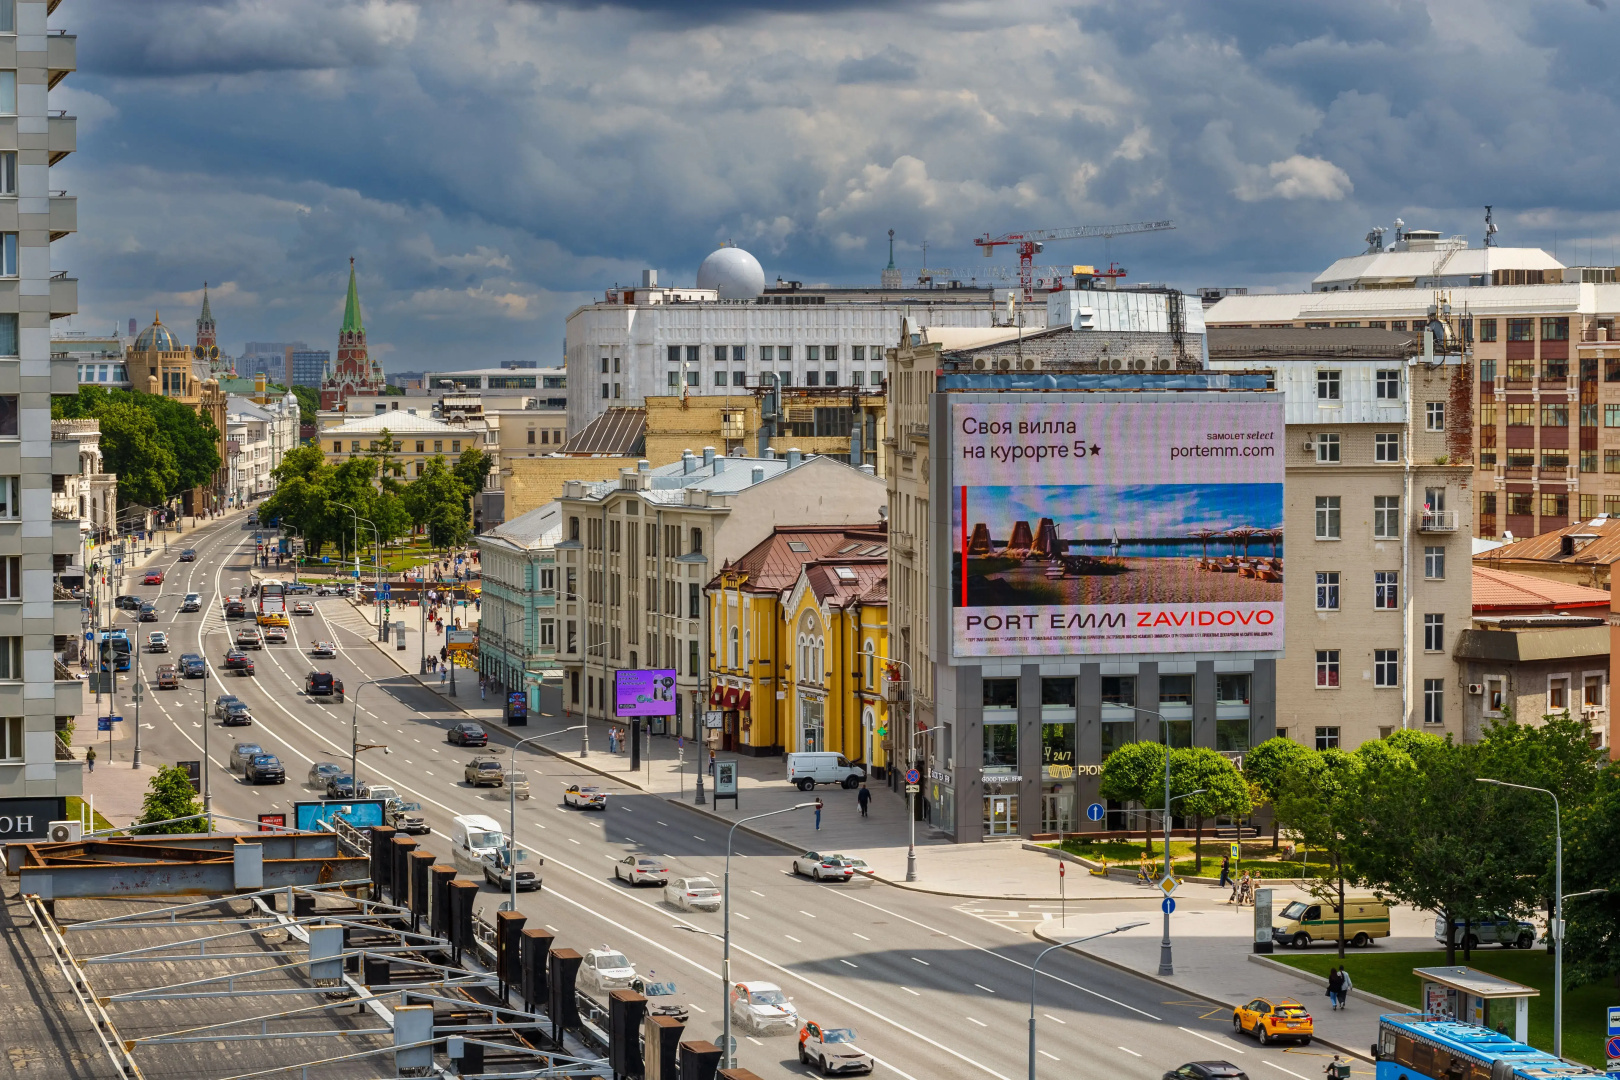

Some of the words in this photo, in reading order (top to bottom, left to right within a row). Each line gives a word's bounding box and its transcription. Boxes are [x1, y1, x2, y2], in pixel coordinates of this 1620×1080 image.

[962, 417, 1012, 434] Своя
[1018, 421, 1077, 434] вилла
[1246, 431, 1274, 440] select
[963, 445, 985, 458] на
[991, 445, 1068, 462] курорте
[1073, 440, 1087, 458] 5
[1171, 445, 1274, 460] portemm.com
[966, 615, 1039, 630] PORT
[1050, 613, 1126, 629] EMM
[1137, 610, 1275, 627] ZAVIDOVO
[1053, 751, 1072, 761] 24/7
